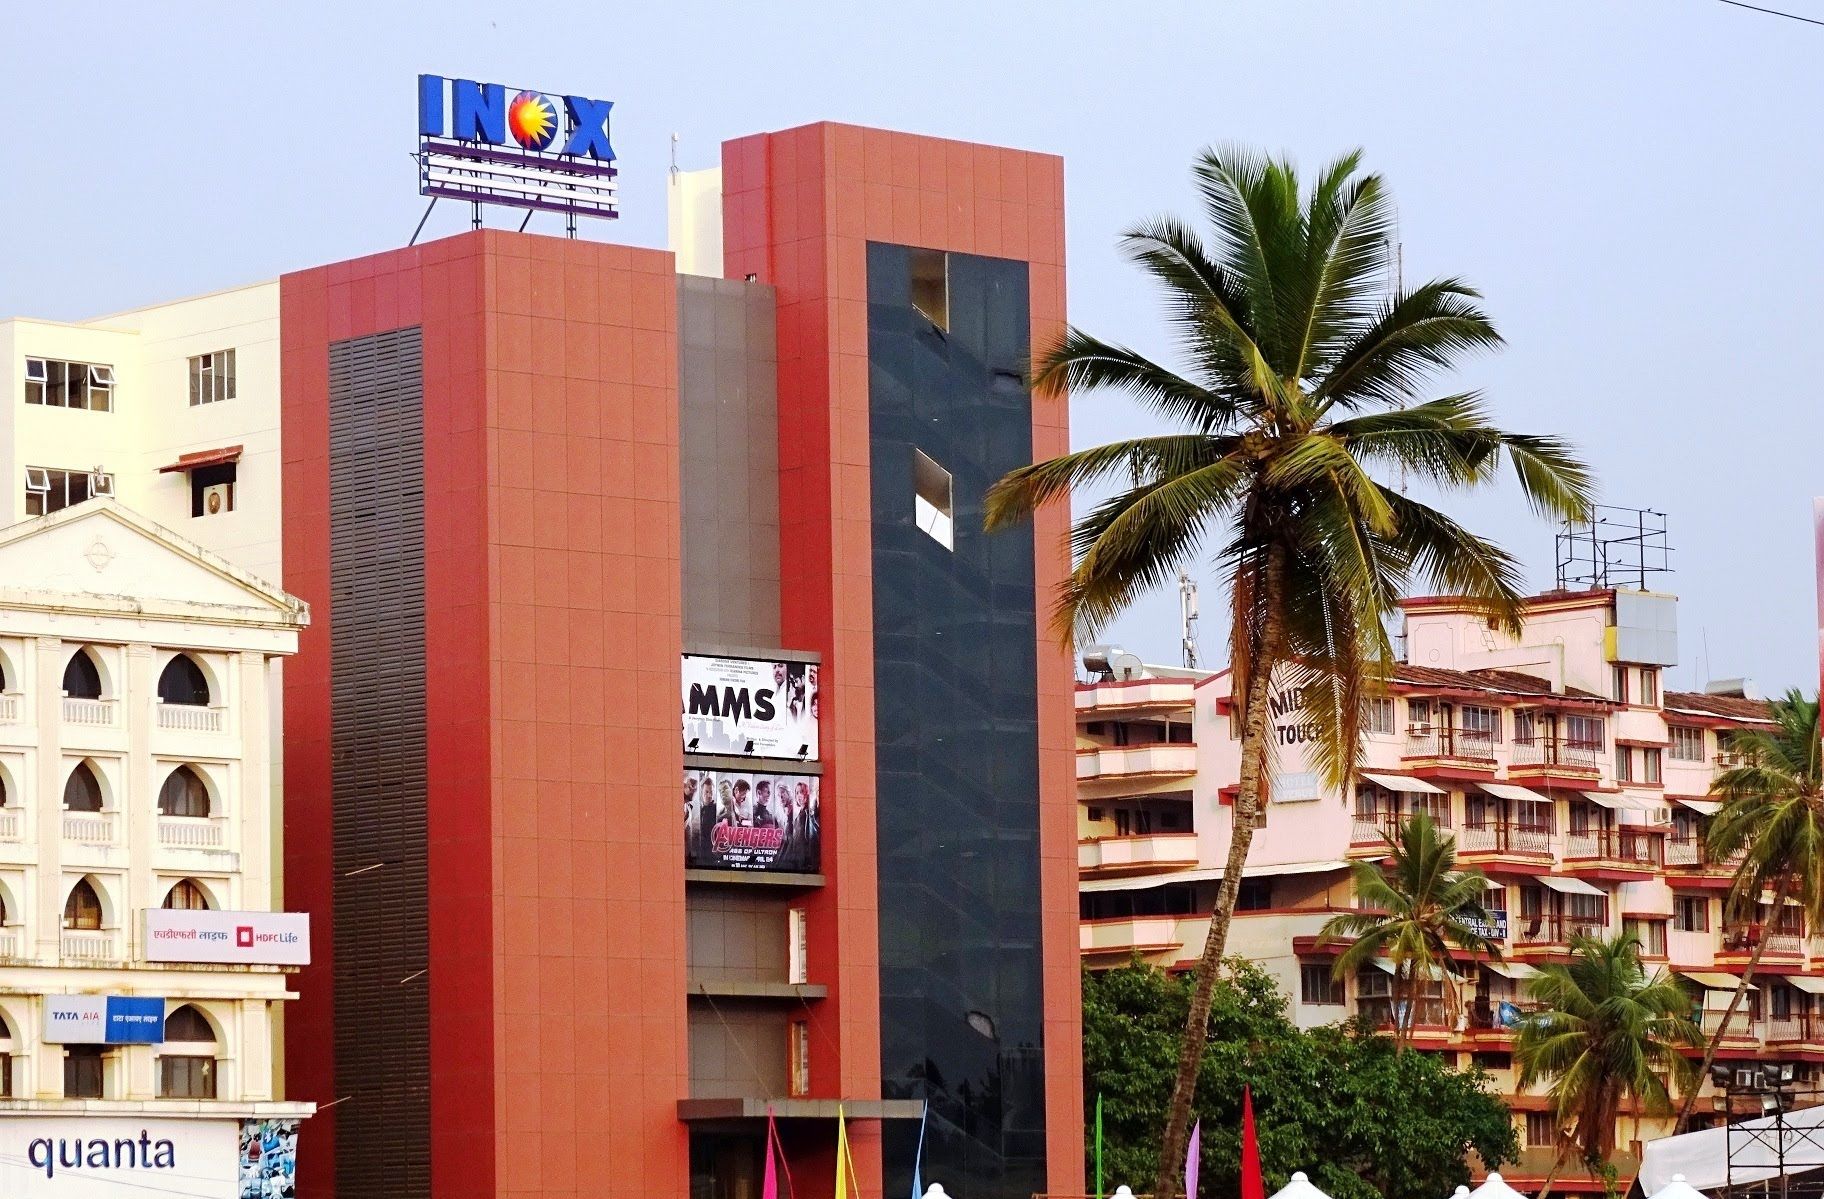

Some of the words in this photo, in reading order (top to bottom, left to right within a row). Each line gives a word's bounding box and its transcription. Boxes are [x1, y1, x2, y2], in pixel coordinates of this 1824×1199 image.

[418, 74, 617, 160] INOX
[688, 682, 776, 727] MMS
[711, 818, 784, 852] AVENGERS
[199, 931, 228, 942] लाइफ
[256, 934, 279, 943] HDFC
[279, 932, 298, 944] Life
[53, 1011, 79, 1020] TATA
[83, 1012, 99, 1021] AIA
[28, 1129, 175, 1179] quanta
